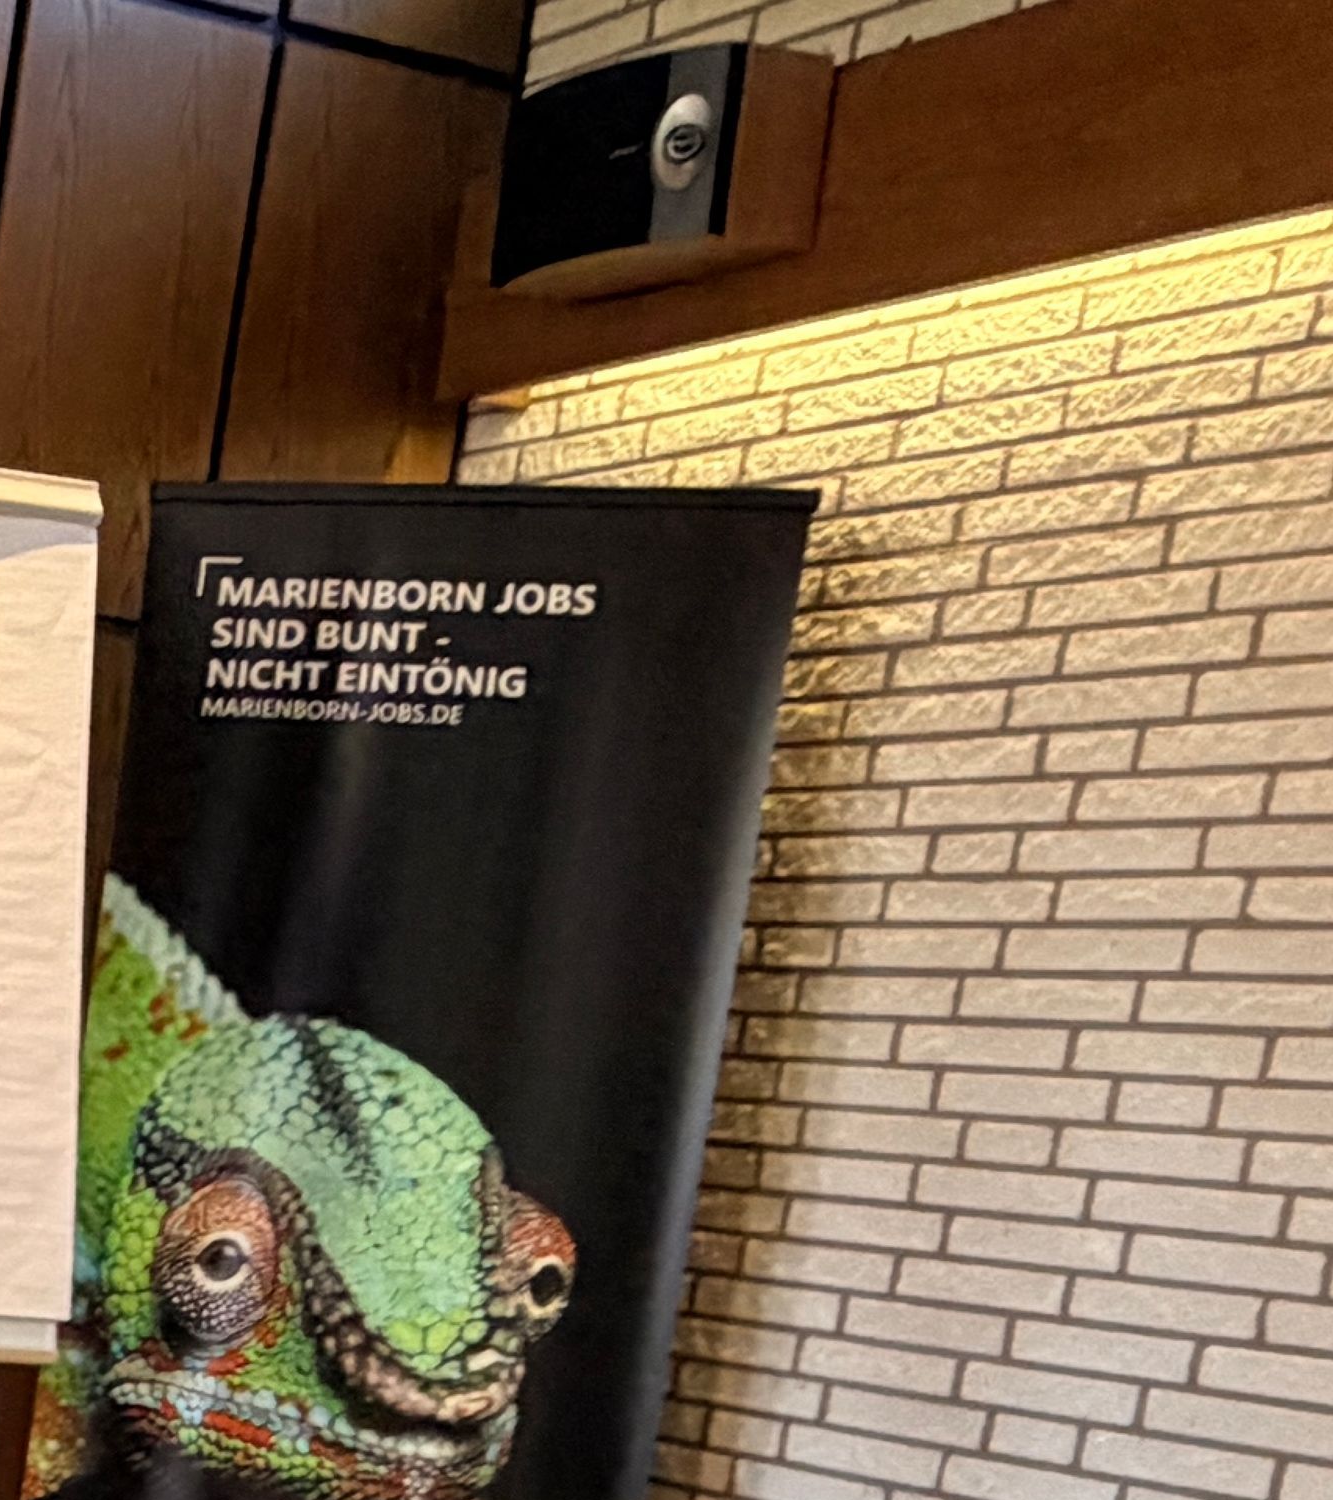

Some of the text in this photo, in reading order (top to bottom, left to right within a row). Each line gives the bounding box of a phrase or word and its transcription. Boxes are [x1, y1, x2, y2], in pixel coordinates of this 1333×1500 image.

[216, 577, 597, 616] MARIENBORN JOBS
[211, 618, 305, 650] SIND
[315, 621, 427, 653] BUNT
[206, 656, 527, 699] NICHT EINTÖNIG
[200, 697, 464, 725] MARIENBORN-JOBS.DE
